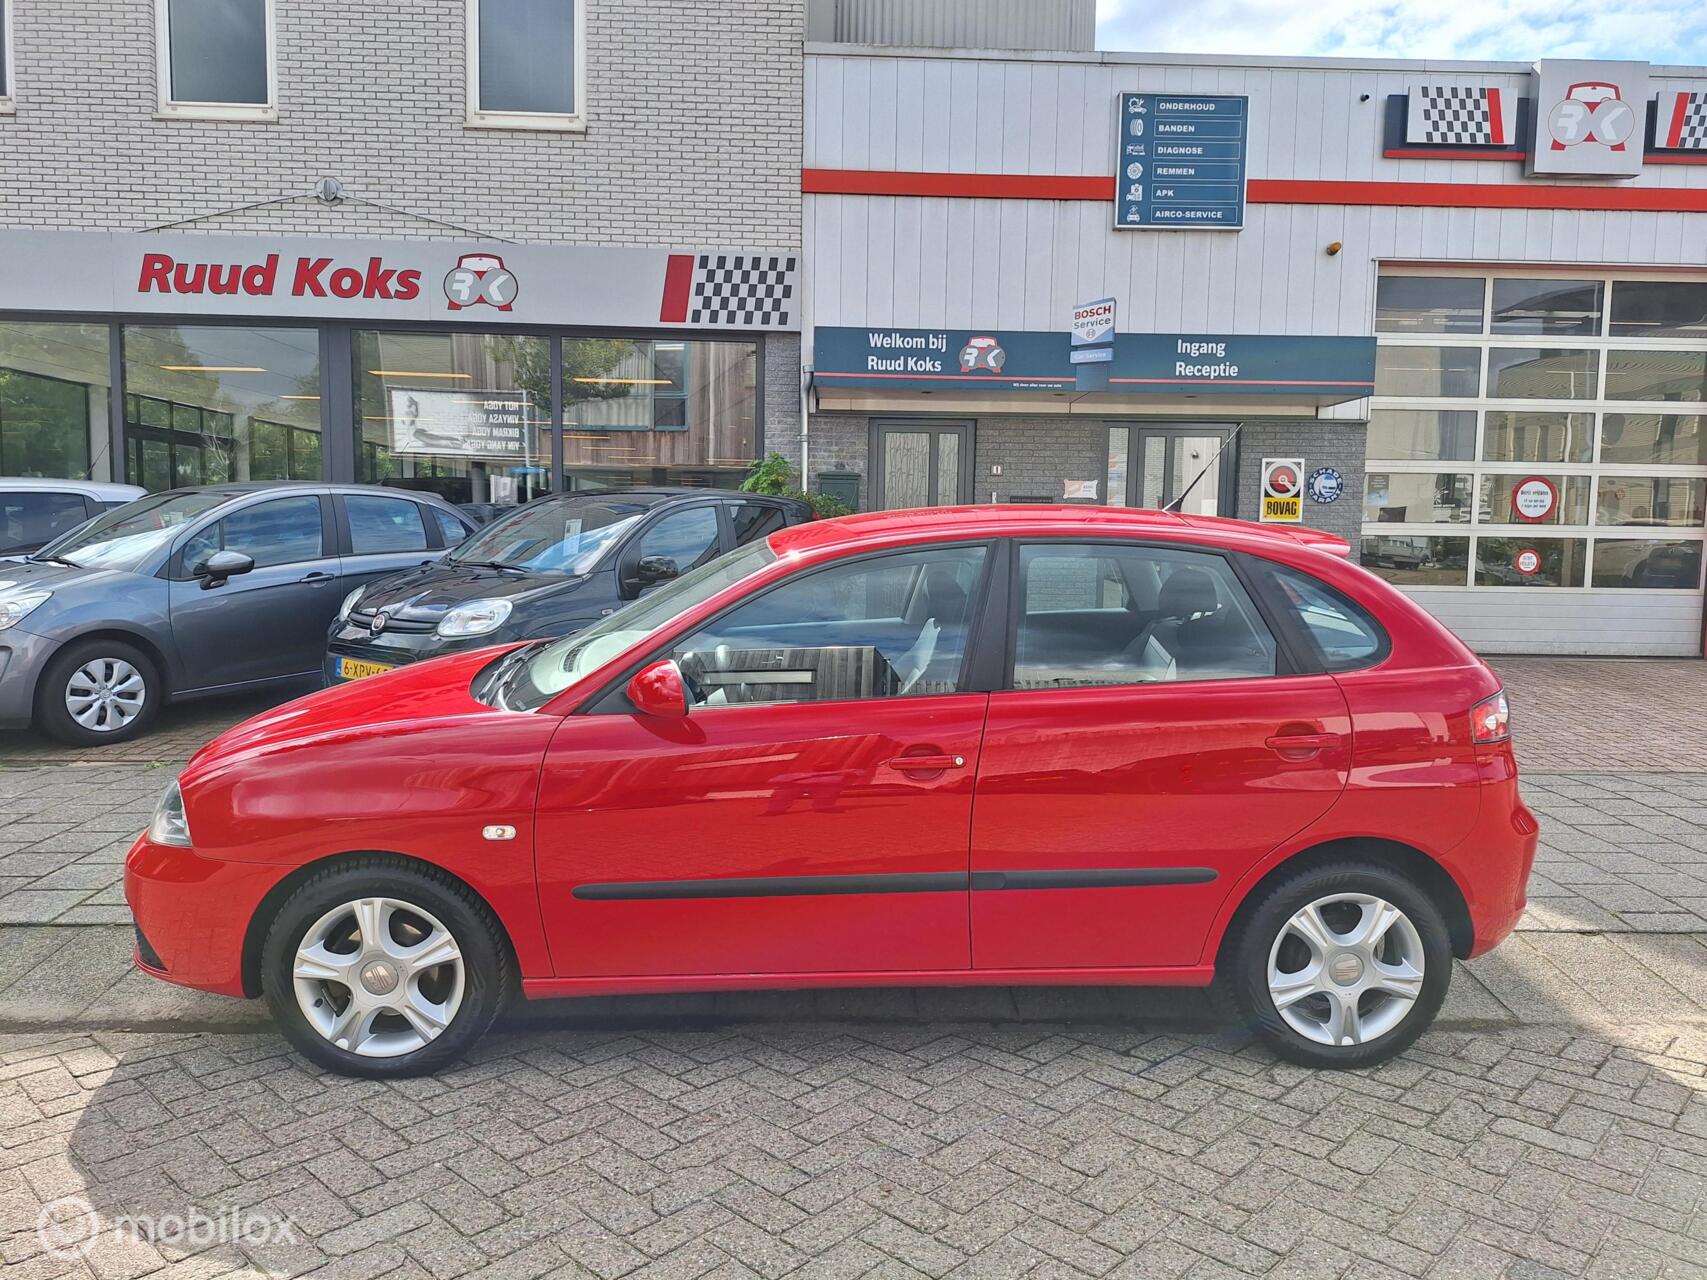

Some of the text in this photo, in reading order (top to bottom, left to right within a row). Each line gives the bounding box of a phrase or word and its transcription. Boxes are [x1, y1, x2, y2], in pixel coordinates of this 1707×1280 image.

[1159, 102, 1216, 111] ONDERHOUD
[1158, 124, 1195, 133] BANDEN
[1157, 146, 1203, 155] DIAGNOSE
[1156, 167, 1195, 176] REMMEN
[1155, 189, 1174, 197] APK
[1154, 210, 1223, 219] AIRCO-SERVICE
[138, 253, 422, 300] Ruud Koks
[1074, 304, 1112, 320] BOSCH
[1073, 317, 1112, 330] Service
[868, 332, 947, 352] Welkom bij
[1176, 338, 1226, 357] Ingang
[866, 355, 942, 372] Ruud Koks
[1175, 361, 1239, 379] Receptie
[1266, 501, 1297, 516] BOVAG
